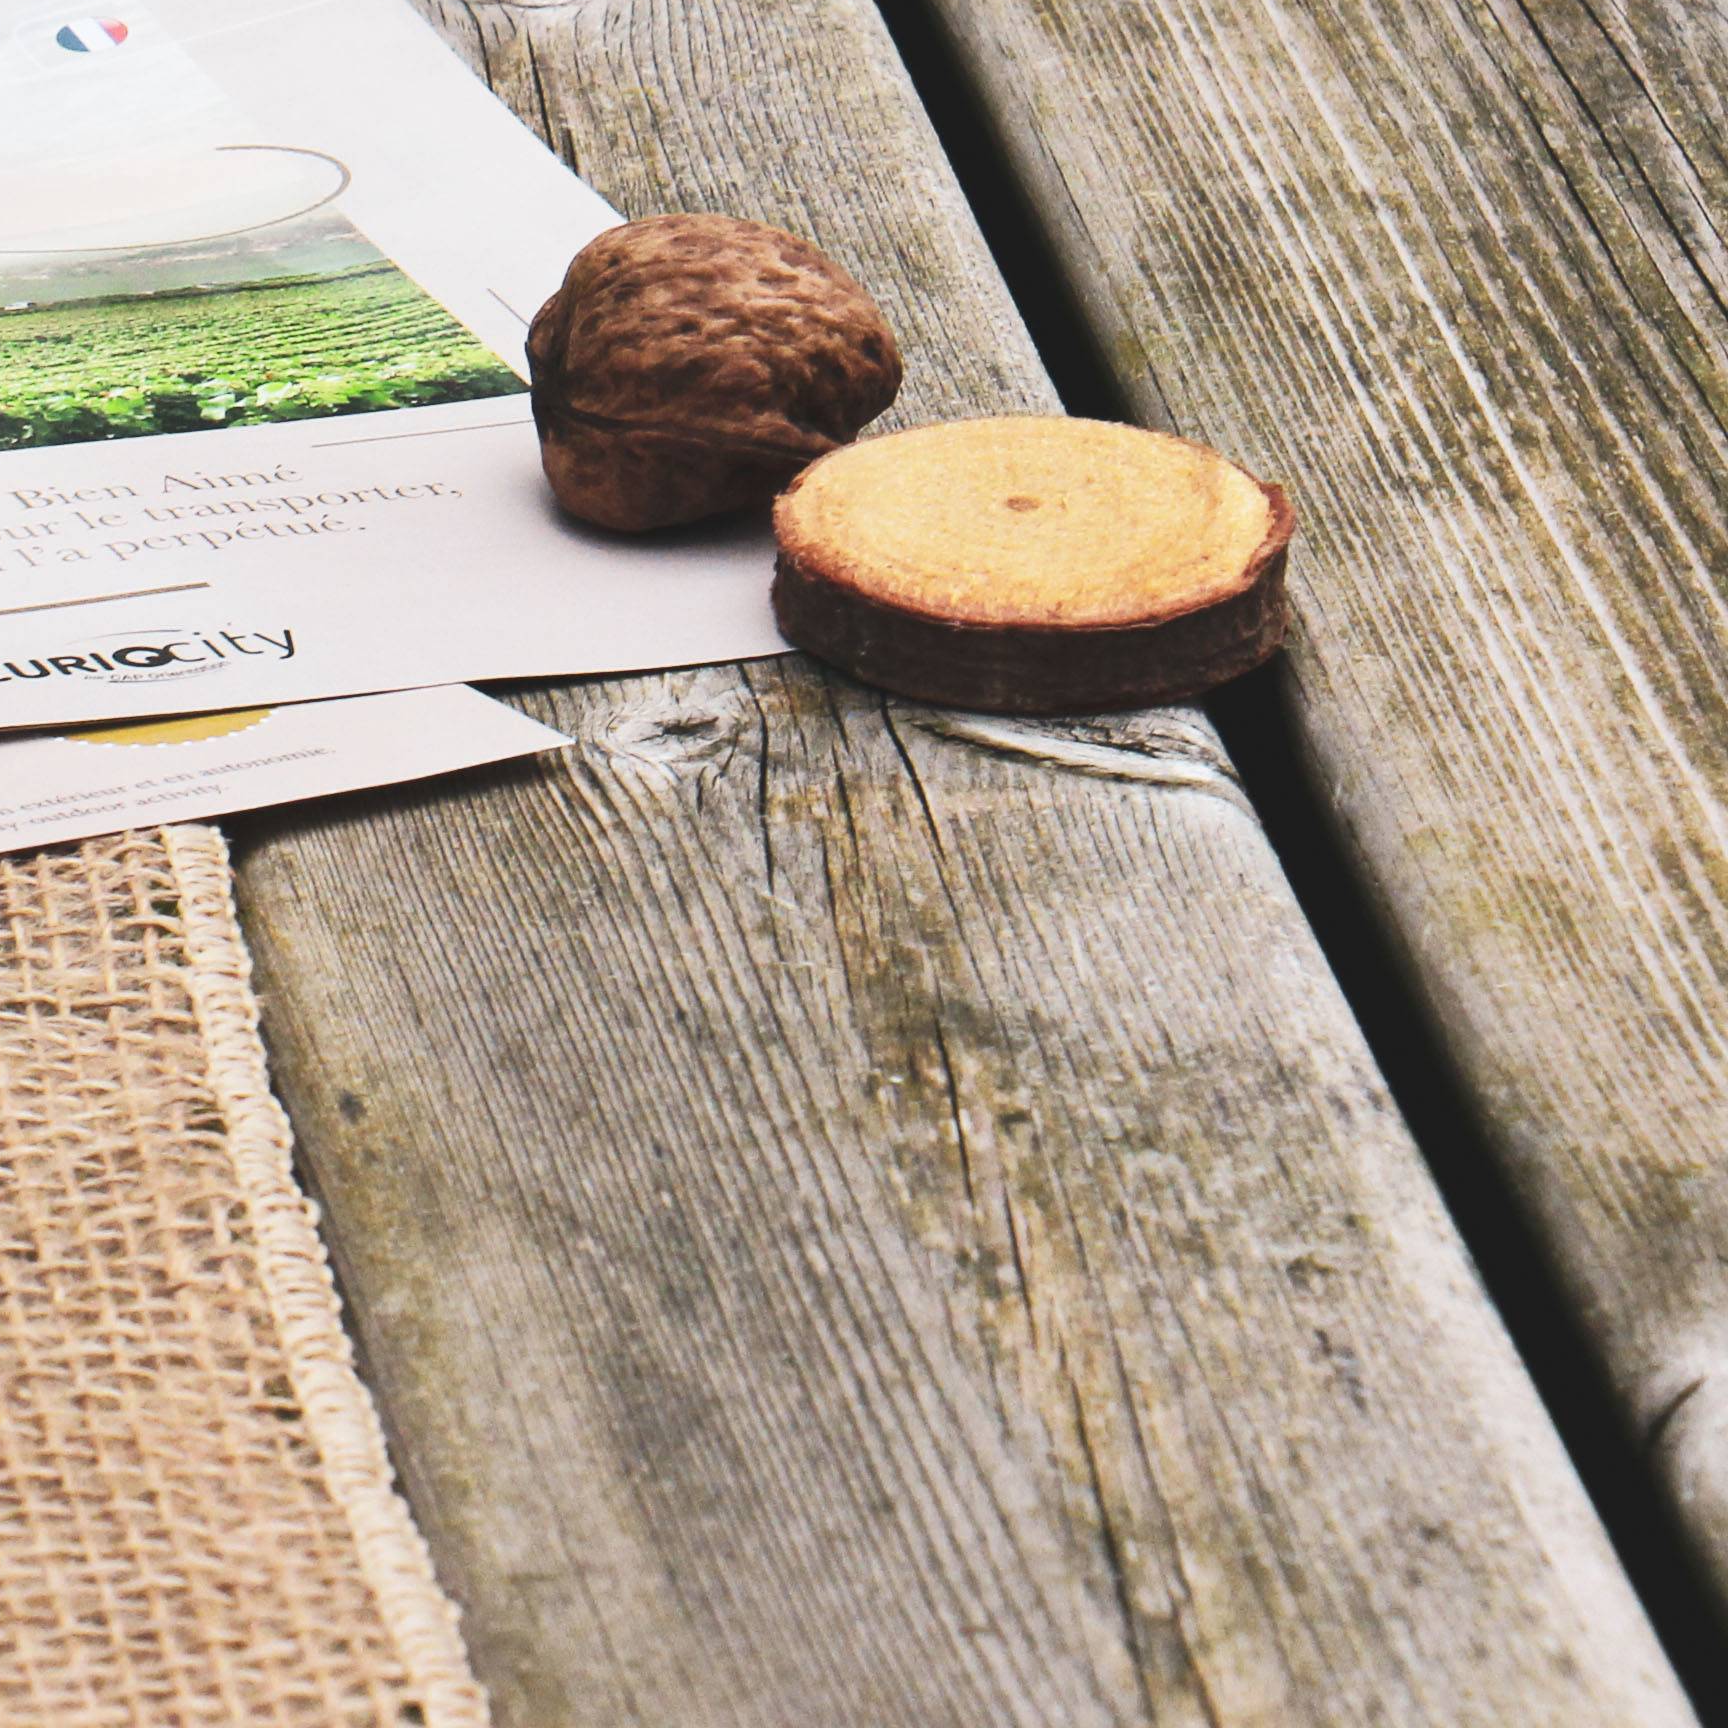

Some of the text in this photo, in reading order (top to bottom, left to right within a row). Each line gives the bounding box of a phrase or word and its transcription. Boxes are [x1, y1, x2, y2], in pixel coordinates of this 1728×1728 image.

[10, 485, 138, 511] Bien
[160, 463, 305, 494] Aimé
[79, 510, 128, 532] le
[143, 480, 465, 524] transporter,
[103, 513, 369, 563] perpétué.
